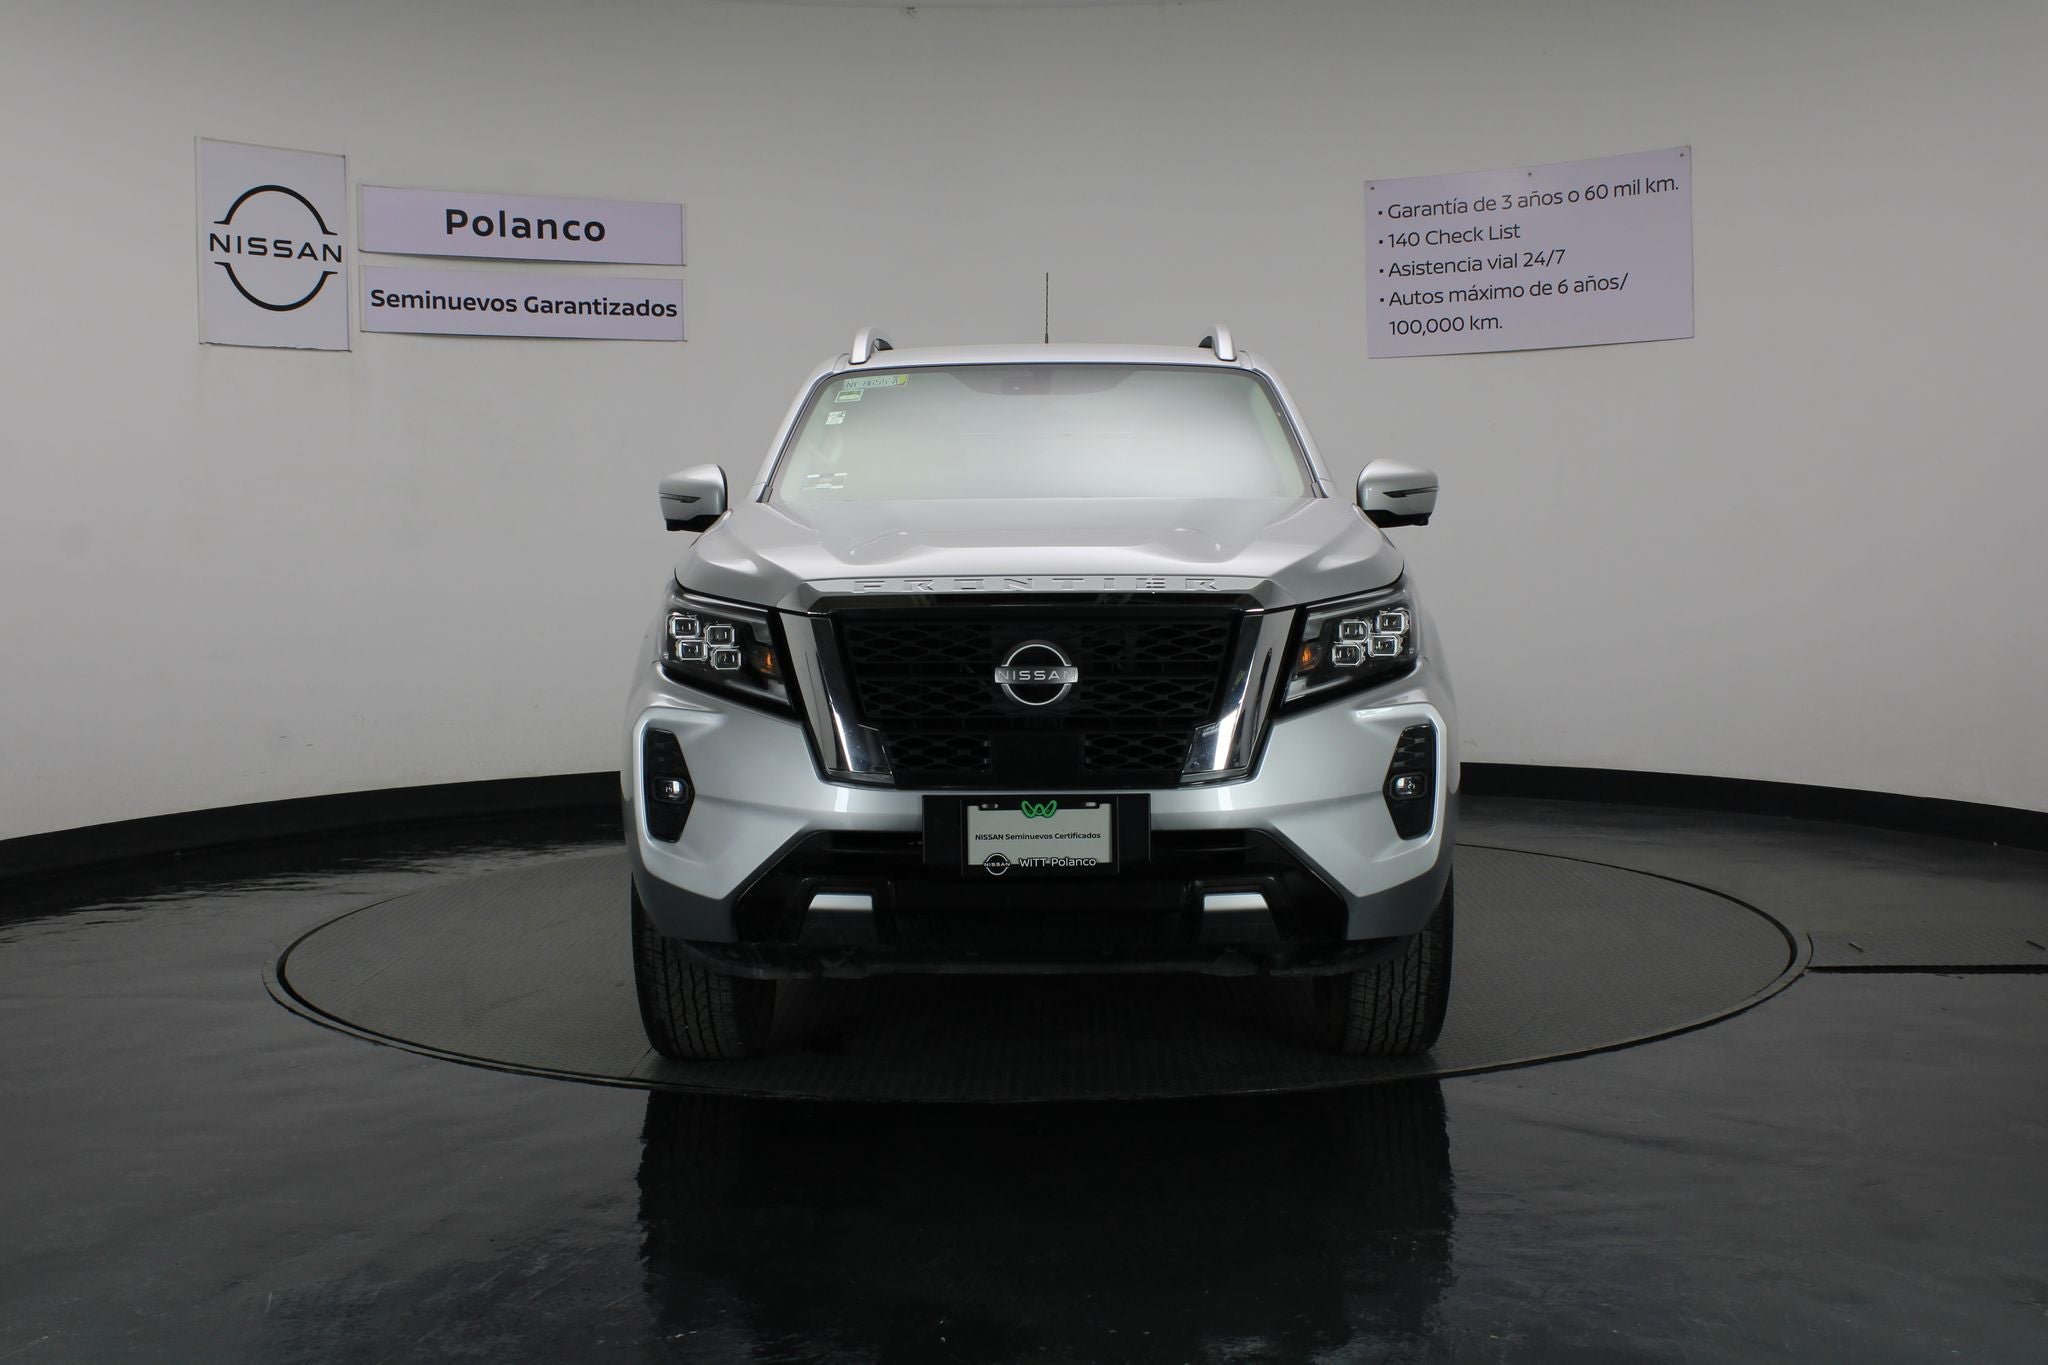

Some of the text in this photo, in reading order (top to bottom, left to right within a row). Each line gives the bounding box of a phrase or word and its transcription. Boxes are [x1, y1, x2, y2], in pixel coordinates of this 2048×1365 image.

[1388, 175, 1679, 219] Garantía de 3 años o 60 mil km.
[445, 209, 606, 242] Polanco
[1388, 223, 1521, 248] 140 Check List
[209, 233, 342, 263] NISSAN
[1388, 249, 1566, 277] Asistencia vial 24/7
[1389, 273, 1629, 306] Autos máximo de 6 años/
[370, 289, 678, 318] Seminuevos Garantizados
[1389, 315, 1503, 337] 100,000 km.
[853, 578, 1221, 593] FRONTIER
[998, 670, 1076, 681] NISSAN
[1054, 832, 1101, 840] Certificados
[1051, 857, 1097, 867] Polanco
